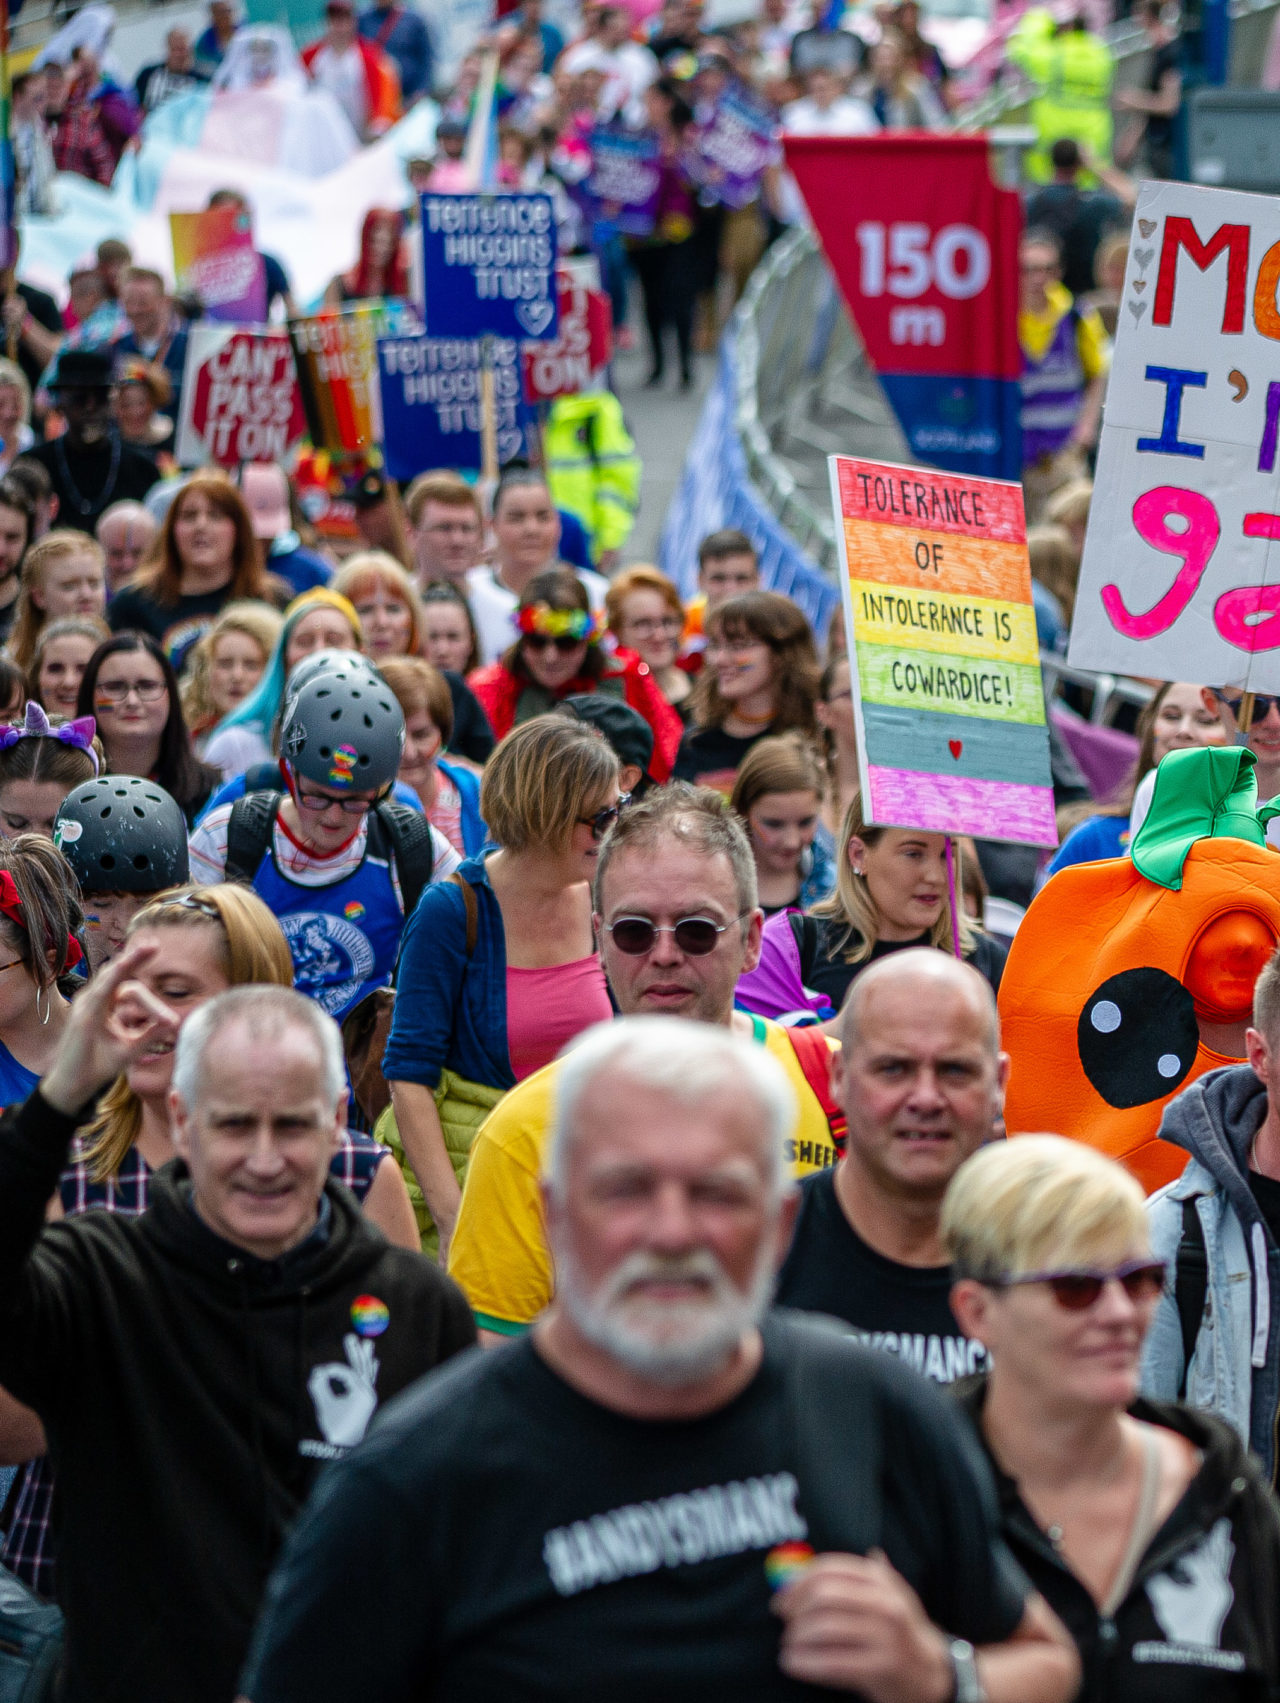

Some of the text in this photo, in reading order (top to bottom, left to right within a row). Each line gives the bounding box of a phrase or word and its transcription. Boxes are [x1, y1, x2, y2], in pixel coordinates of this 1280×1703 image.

[855, 220, 992, 300] 150
[890, 305, 947, 346] m
[857, 474, 985, 527] TOLERANCE
[915, 542, 943, 573] OF
[862, 592, 1012, 643] INTOLERANCE IS
[892, 661, 1013, 708] COWARDICE!
